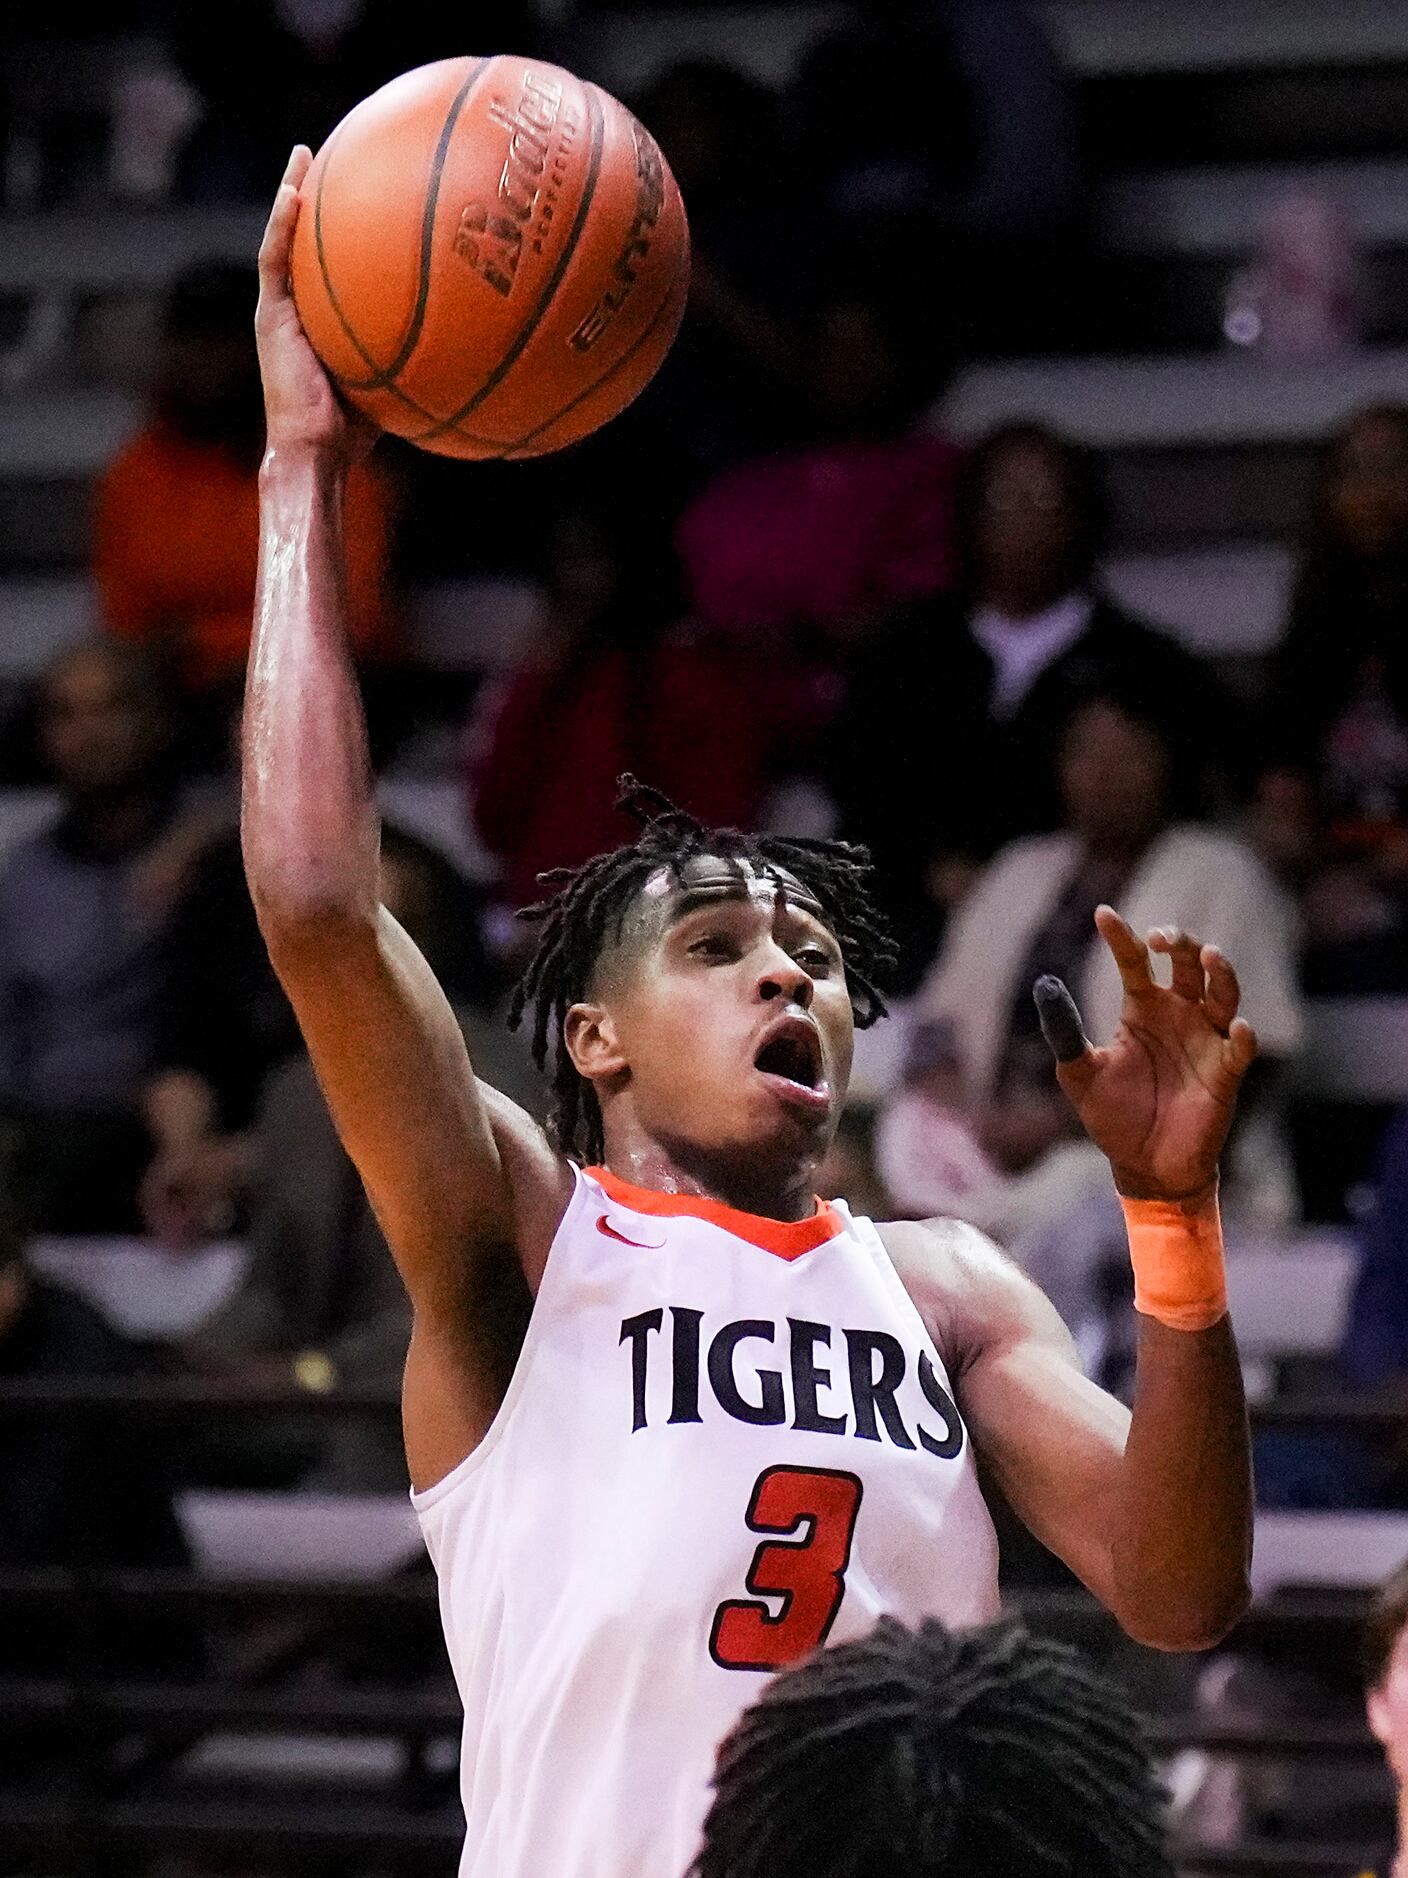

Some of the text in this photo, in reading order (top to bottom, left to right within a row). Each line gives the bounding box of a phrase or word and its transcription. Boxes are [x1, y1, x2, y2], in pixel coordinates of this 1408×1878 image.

[453, 69, 564, 297] Baden
[618, 1306, 965, 1460] TIGERS
[709, 1464, 864, 1672] 3
